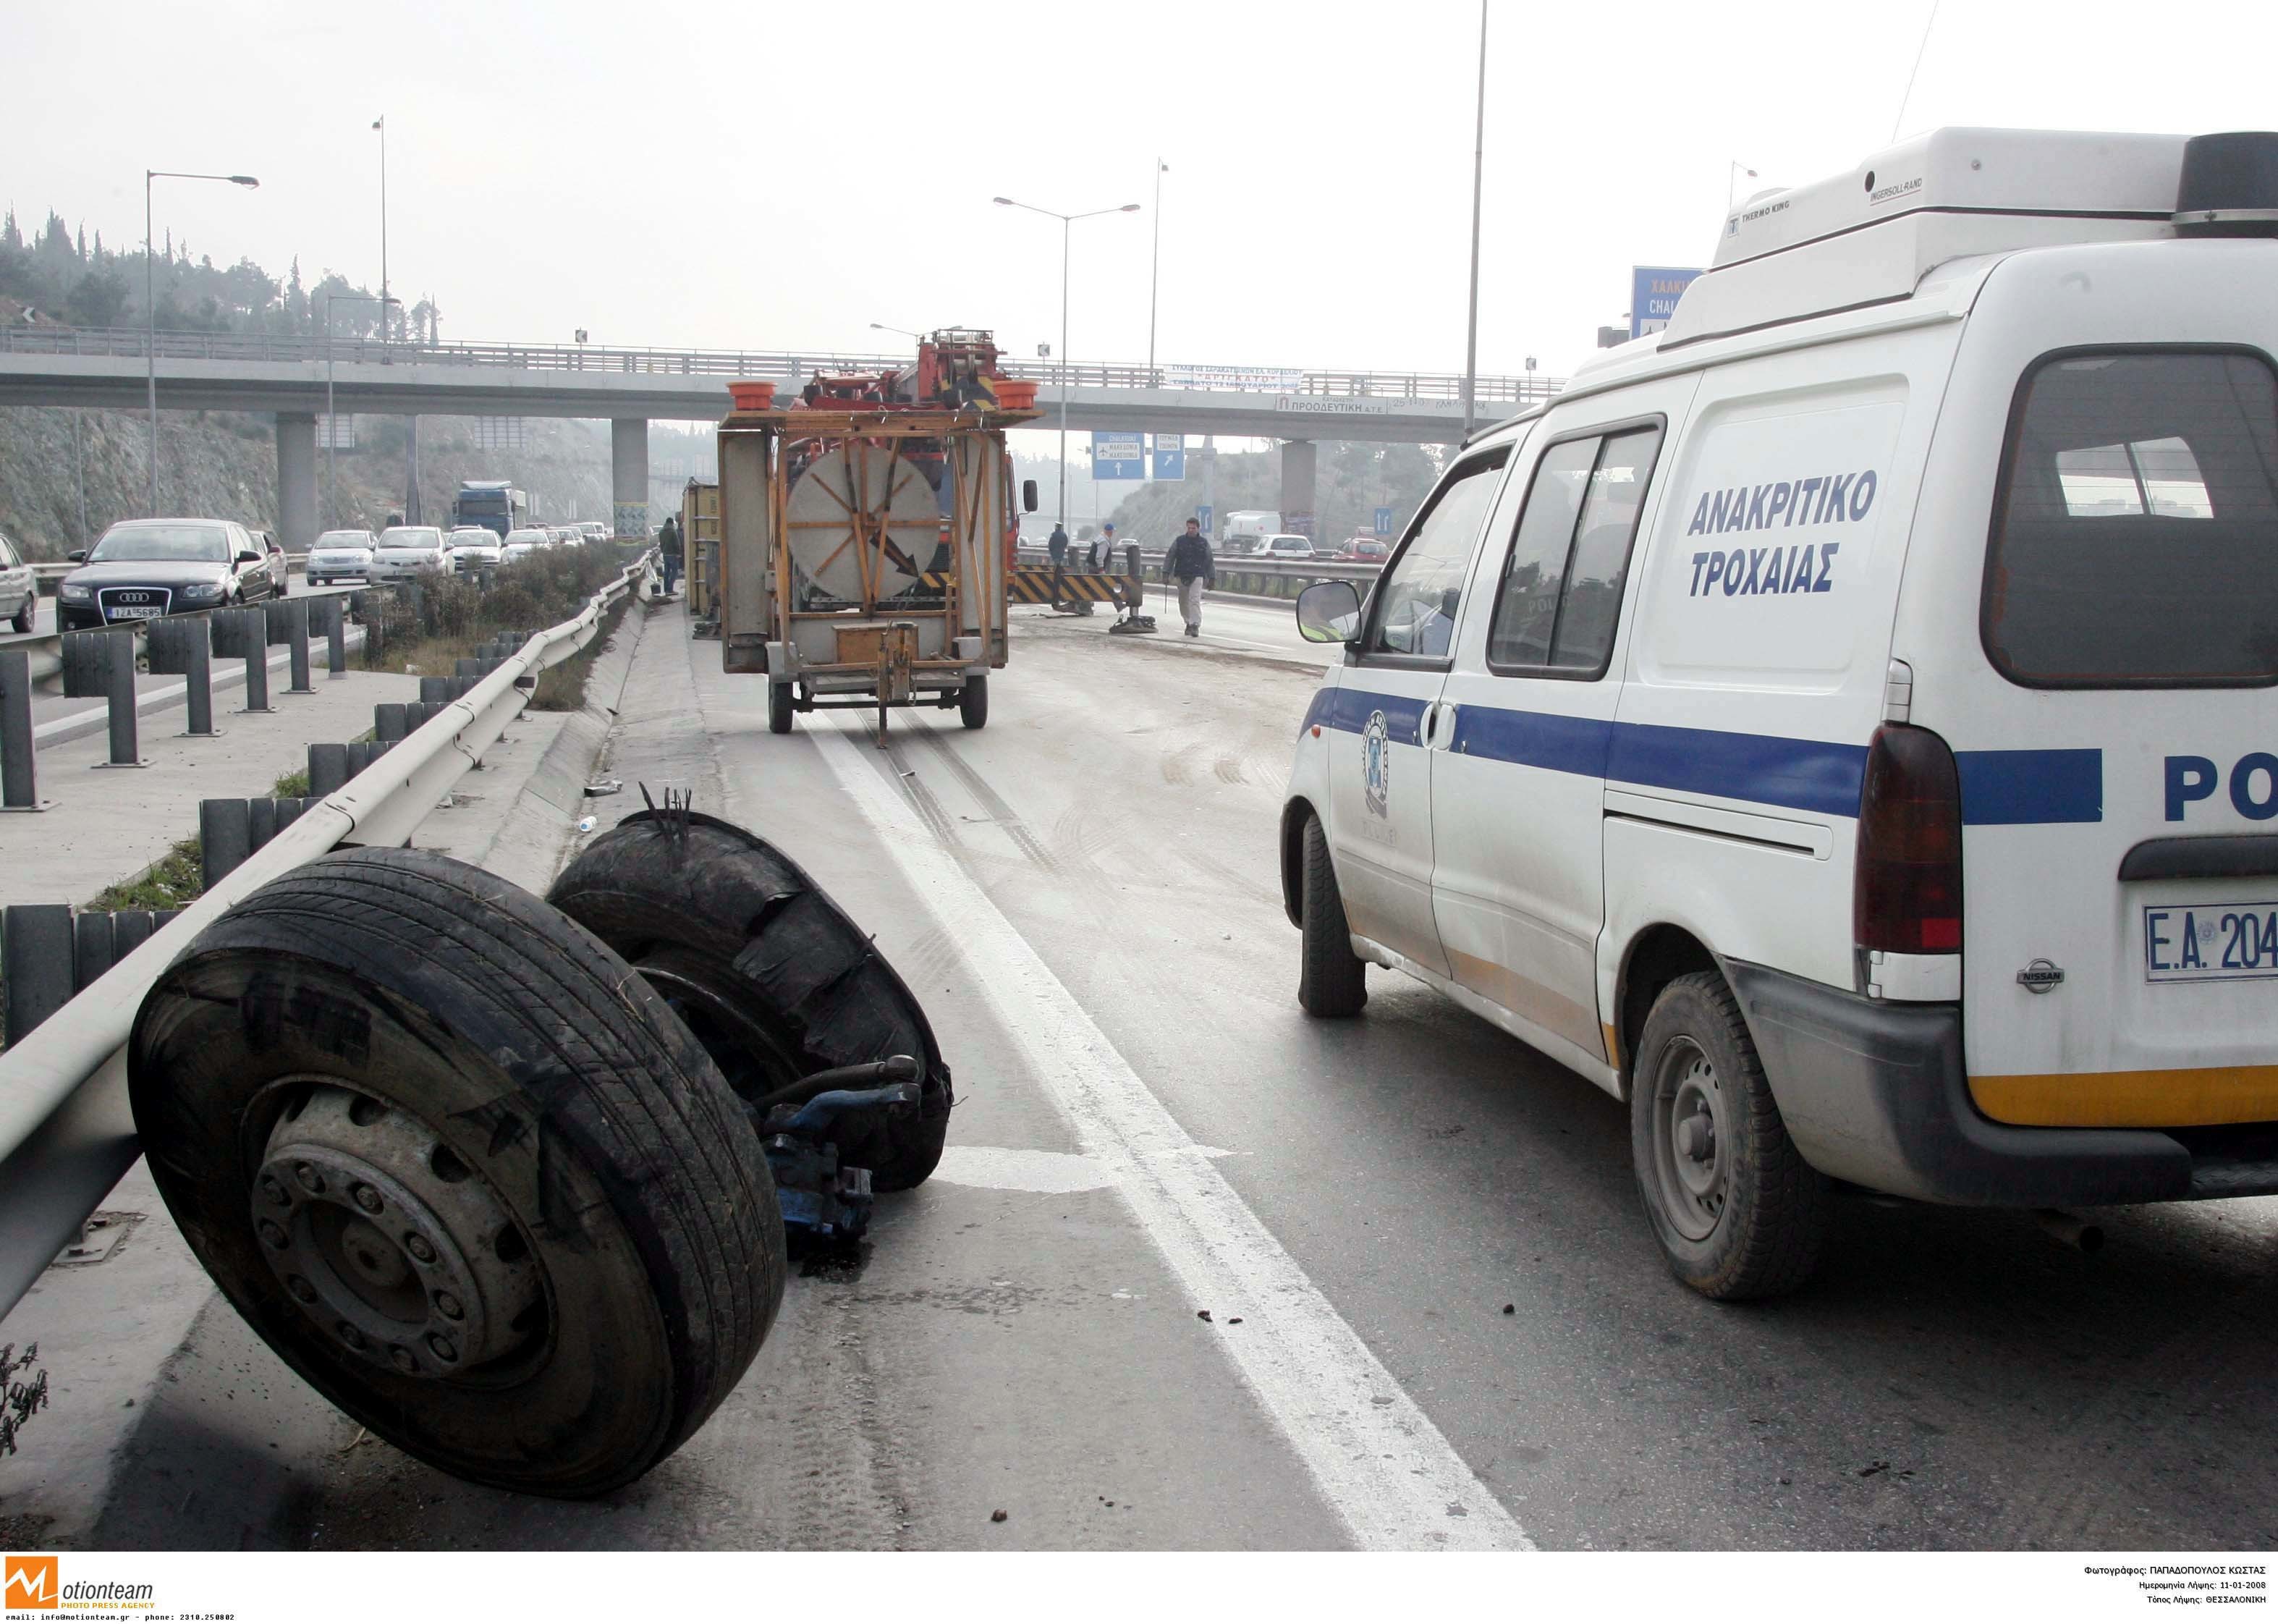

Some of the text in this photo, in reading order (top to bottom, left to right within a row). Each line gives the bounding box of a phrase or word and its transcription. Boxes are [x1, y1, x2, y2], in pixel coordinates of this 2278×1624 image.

[1869, 177, 1923, 203] INGERSOLL-RAND
[1742, 200, 1790, 224] THERMO KING
[1651, 279, 1690, 294] ΧΑΛΚΙ
[1292, 402, 1362, 413] ΠΡΟΟΔΕΥΤΙΚΗ
[1687, 469, 1877, 536] ΑΝΑΚΡΙΤΙΚΟ
[1690, 542, 1840, 597] ΤΡΟΧΑΙΑΣ
[2164, 752, 2278, 822] PO
[2023, 972, 2062, 981] NISSAN
